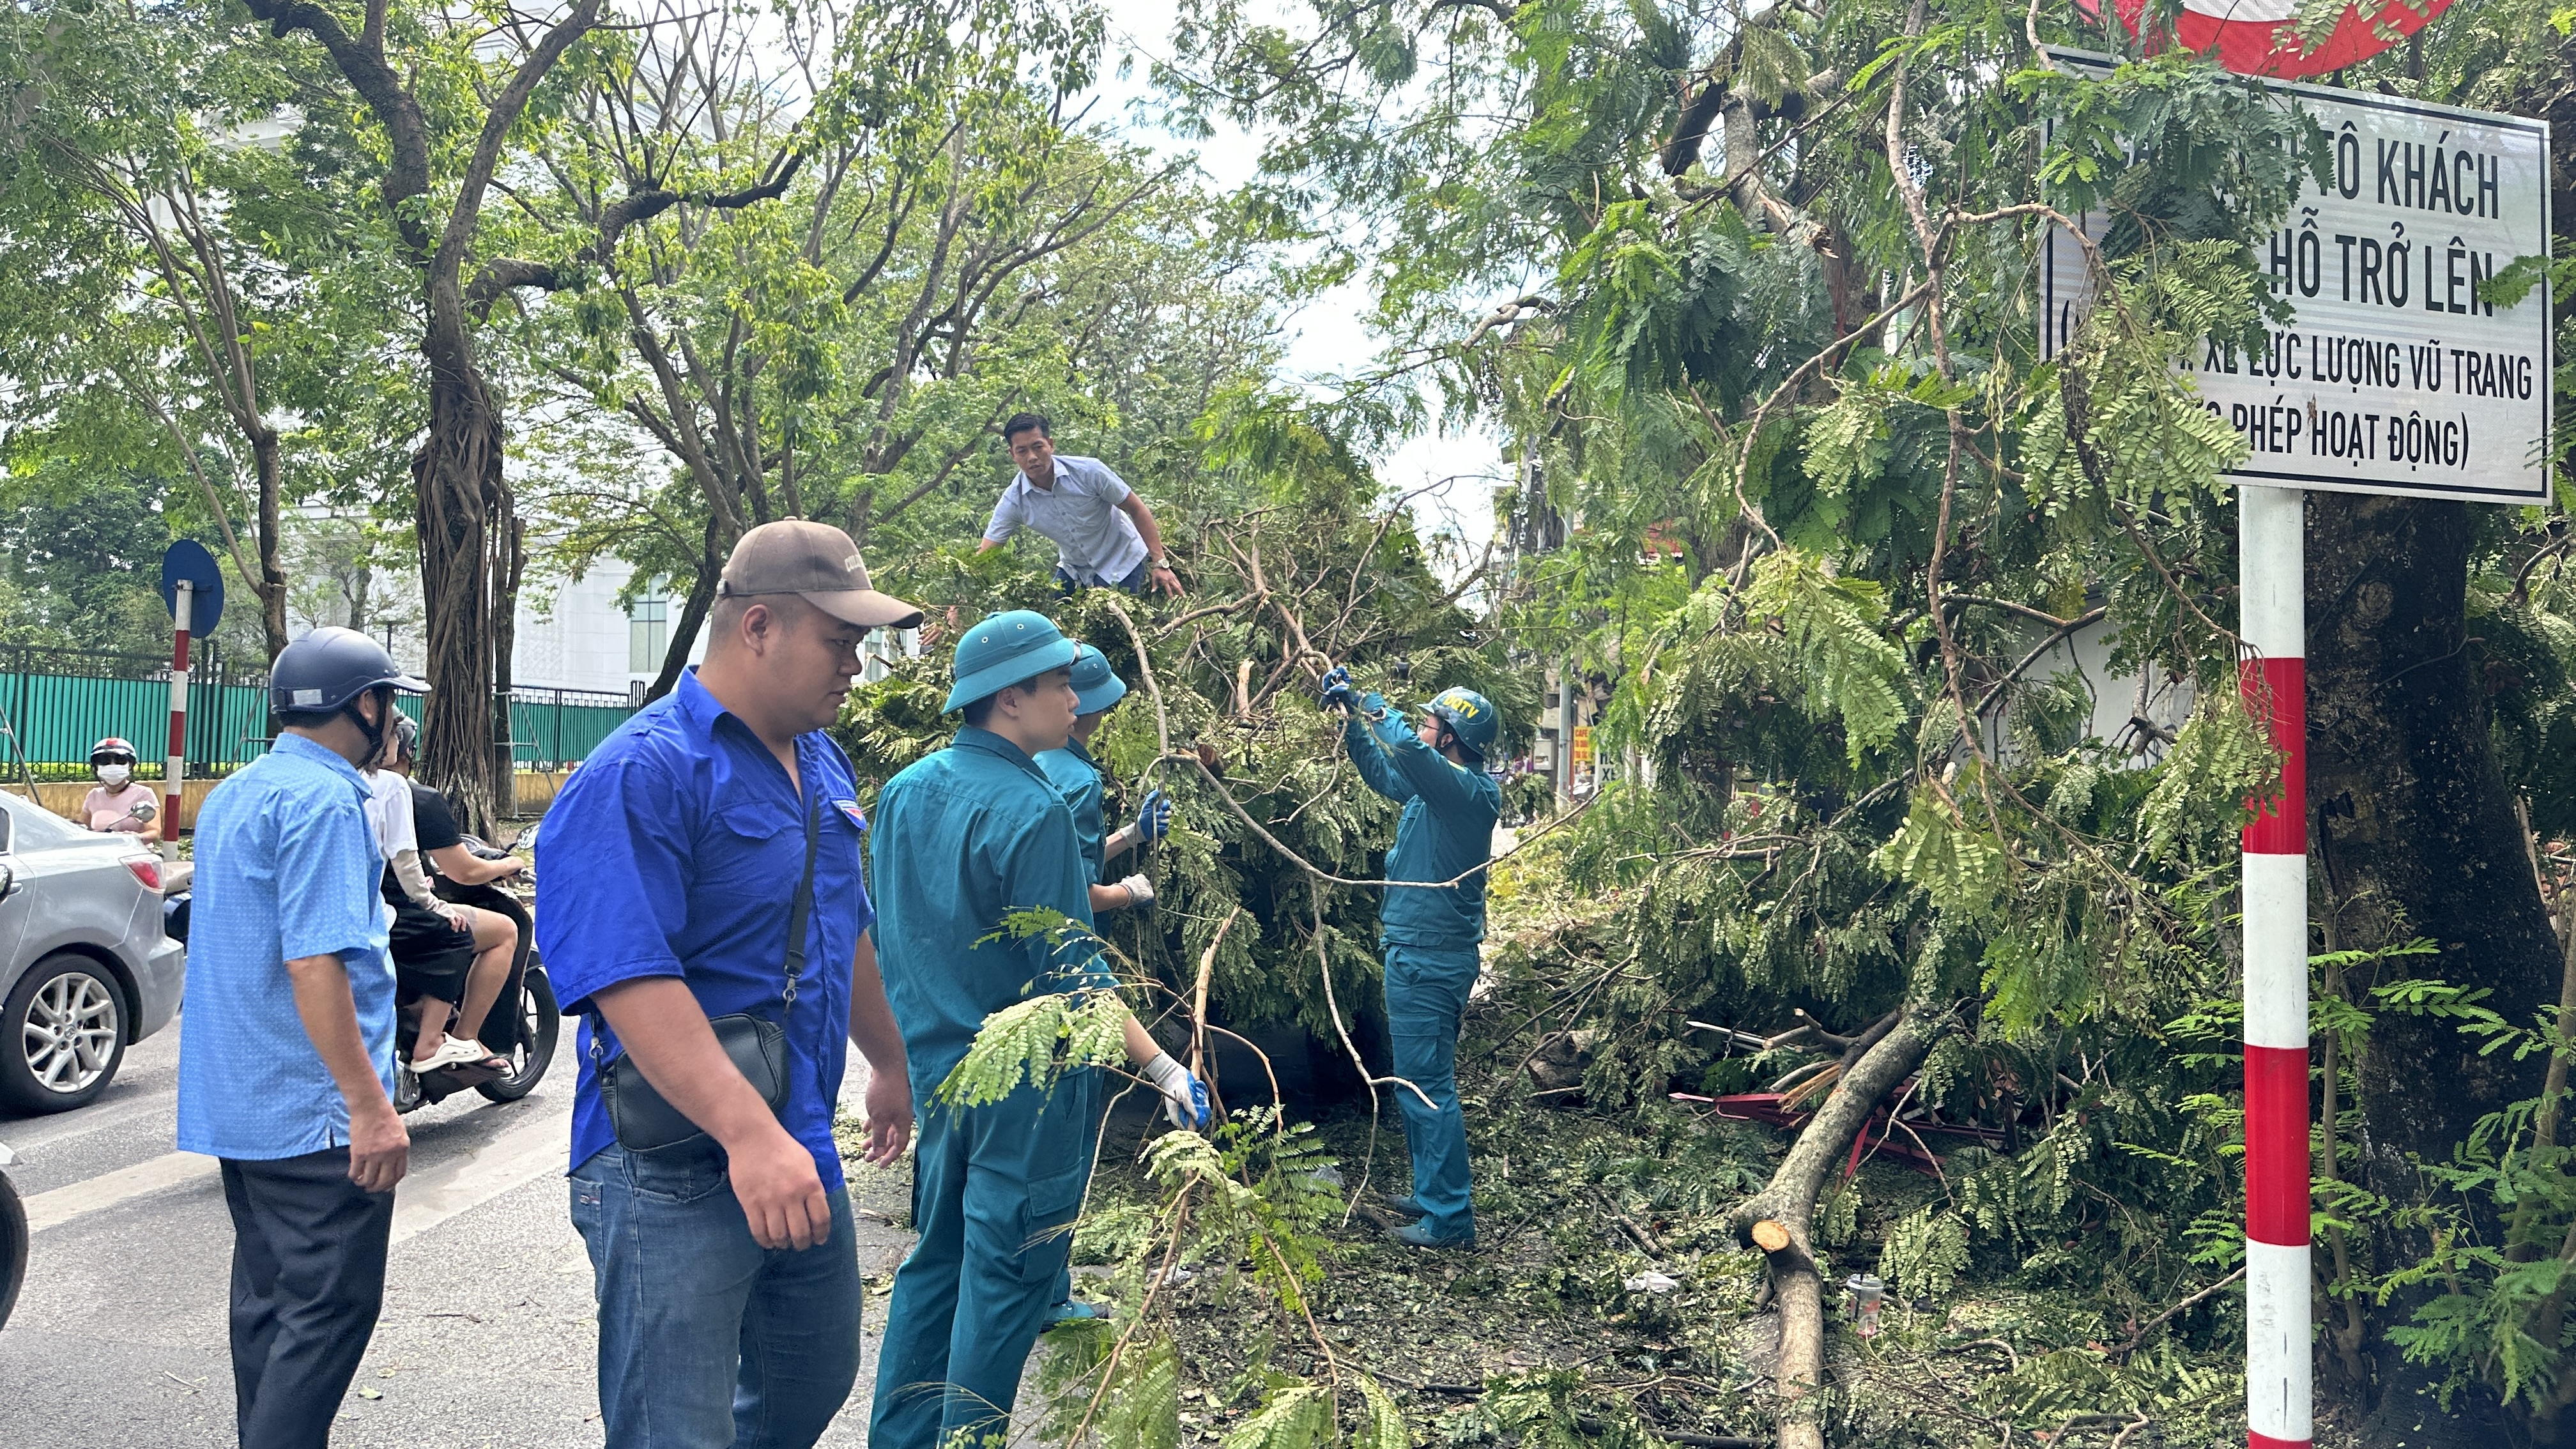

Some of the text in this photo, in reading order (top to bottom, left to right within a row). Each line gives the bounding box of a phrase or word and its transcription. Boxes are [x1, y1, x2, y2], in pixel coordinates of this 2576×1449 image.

[2377, 131, 2499, 220] KHÁCH
[2270, 206, 2493, 317] HỖ TRỞ LÊN
[2312, 335, 2400, 394] LƯỢNG
[2409, 339, 2441, 392] VŨ
[2450, 348, 2532, 401] TRANG
[2233, 394, 2469, 471] PHÉP HOẠT ĐỘNG)
[1443, 693, 1480, 719] DQTV
